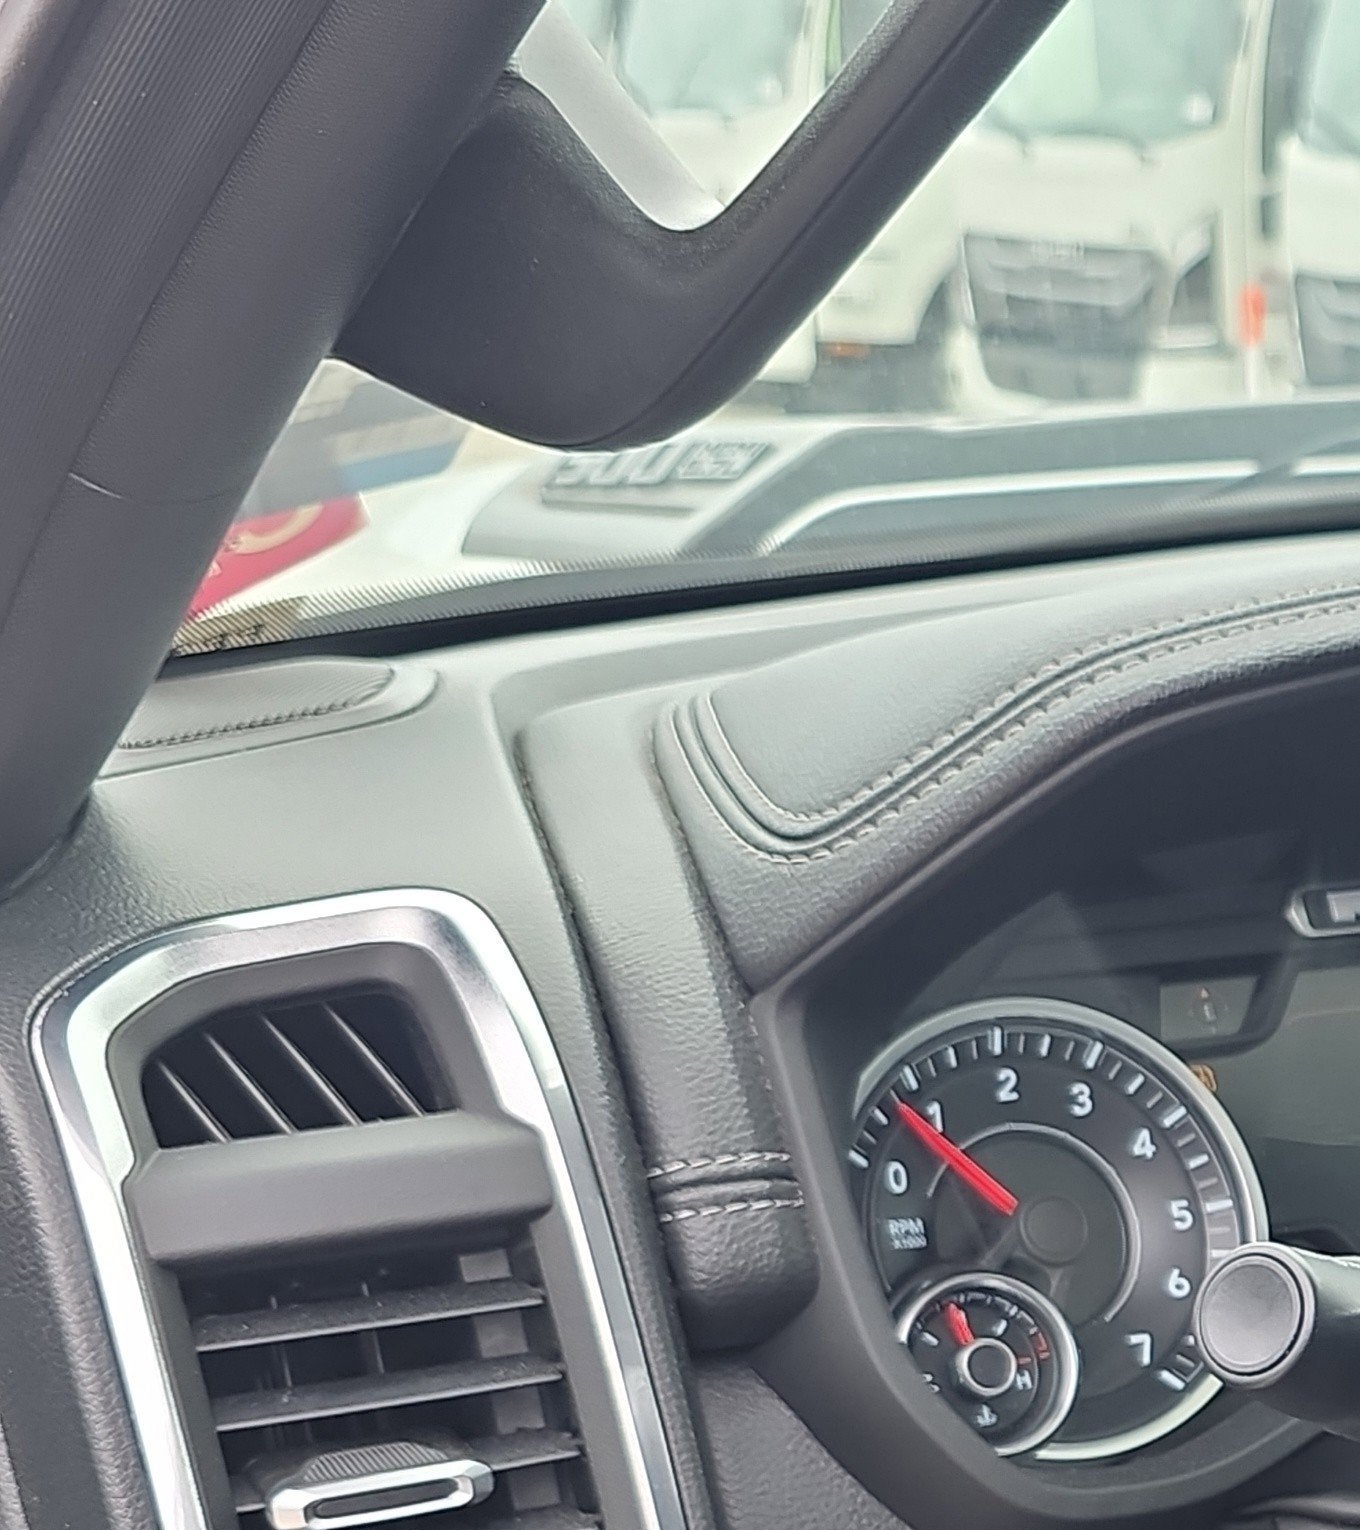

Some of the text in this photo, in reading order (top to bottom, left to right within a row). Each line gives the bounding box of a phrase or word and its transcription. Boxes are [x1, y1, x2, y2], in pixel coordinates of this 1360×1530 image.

[996, 1069, 1020, 1103] 2
[1068, 1084, 1094, 1117] 3
[926, 1102, 945, 1132] 1
[1132, 1127, 1156, 1160] 4
[885, 1161, 908, 1195] 0
[887, 1216, 925, 1236] RPM
[1171, 1199, 1194, 1232] 5
[1167, 1268, 1191, 1298] 6
[1128, 1334, 1153, 1366] 7
[1015, 1368, 1034, 1390] H
